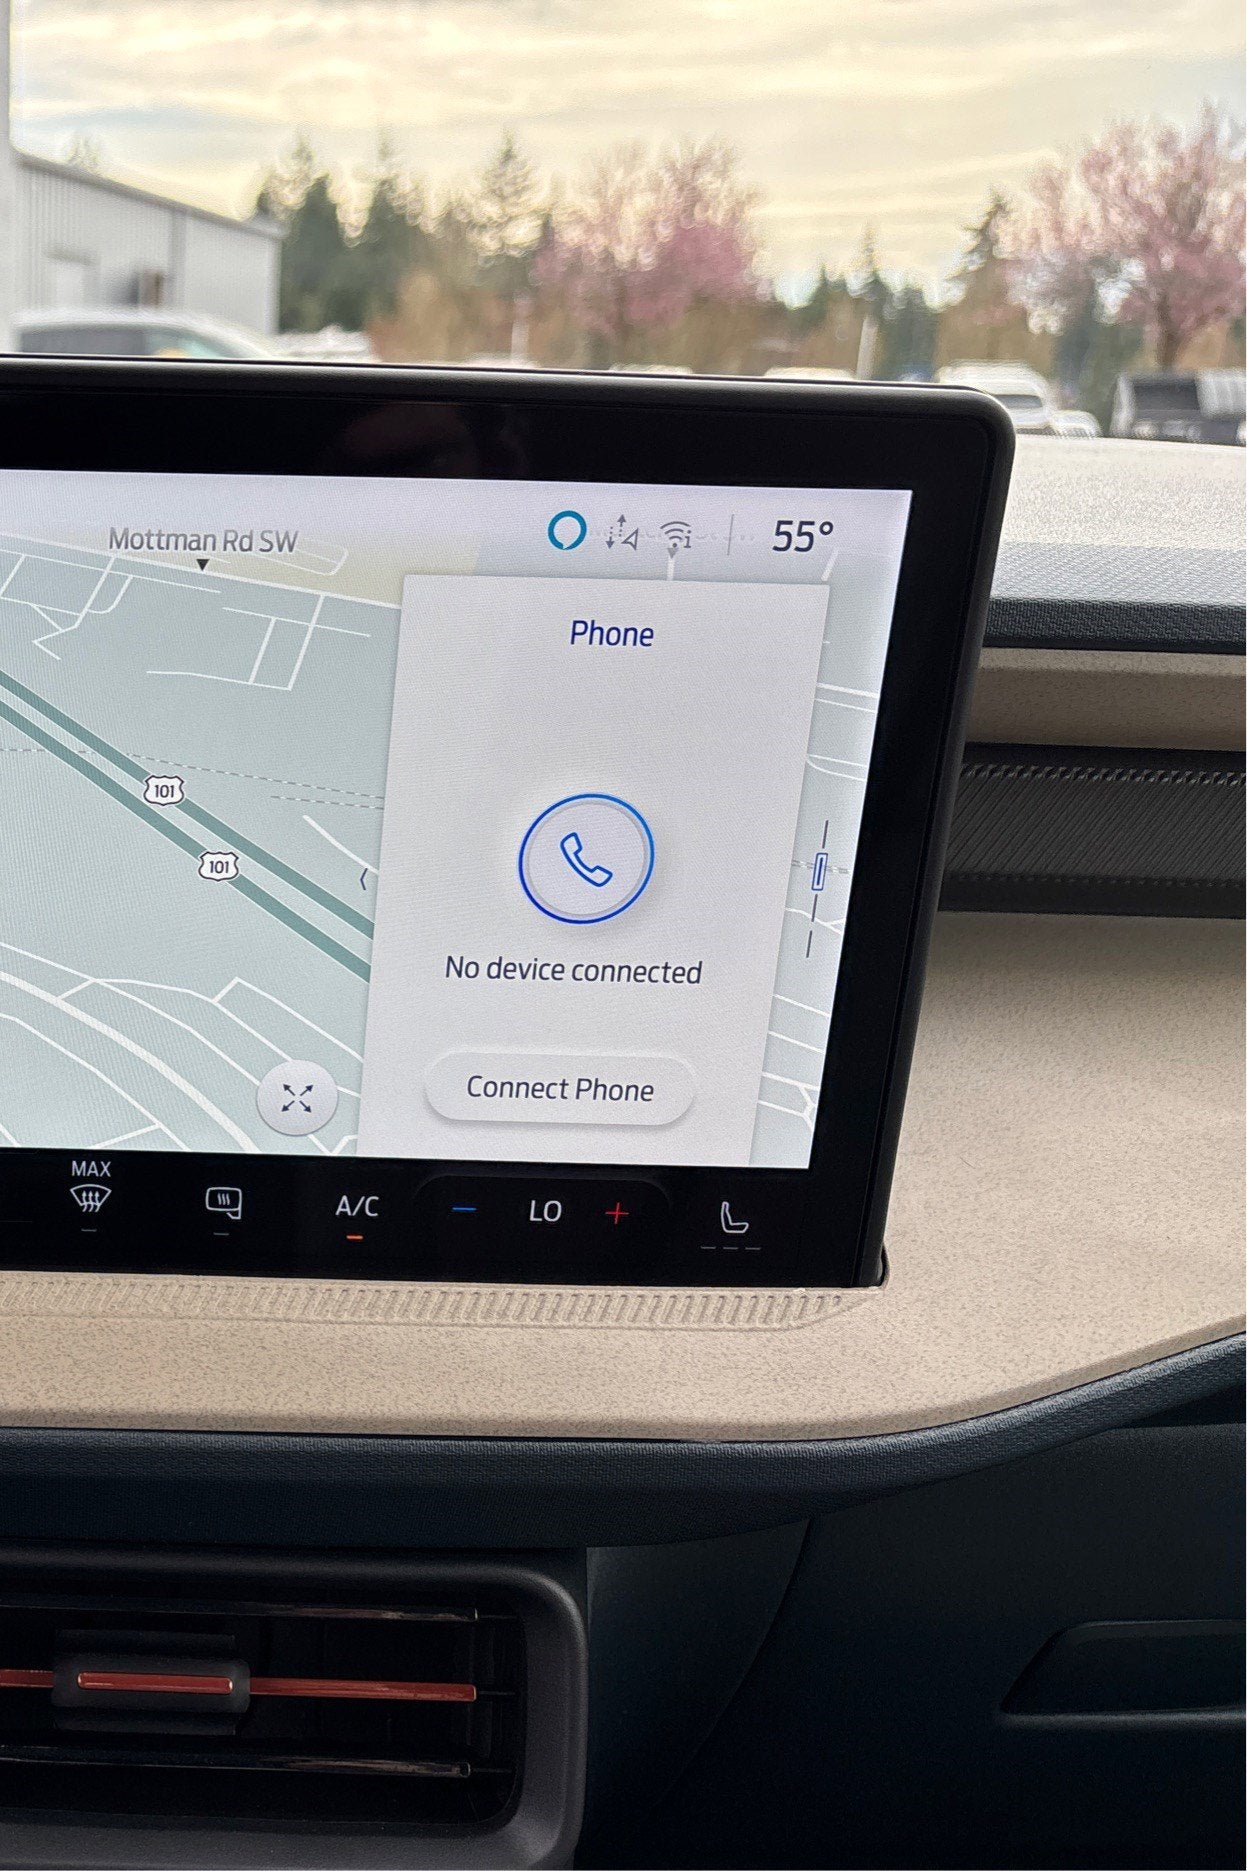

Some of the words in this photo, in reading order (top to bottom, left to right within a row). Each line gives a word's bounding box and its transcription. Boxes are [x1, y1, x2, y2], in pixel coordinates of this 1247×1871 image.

[109, 527, 217, 551] Mottman
[224, 530, 253, 552] Rd
[259, 531, 299, 553] SW
[569, 619, 654, 647] Phone
[154, 784, 175, 798] 101
[209, 860, 230, 874] 101
[445, 955, 479, 979] No
[486, 957, 565, 982] device
[571, 960, 702, 985] connected
[467, 1075, 569, 1100] Connect
[575, 1078, 654, 1102] Phone
[71, 1161, 111, 1178] MAX
[335, 1195, 379, 1217] A/C
[529, 1200, 562, 1222] LO
